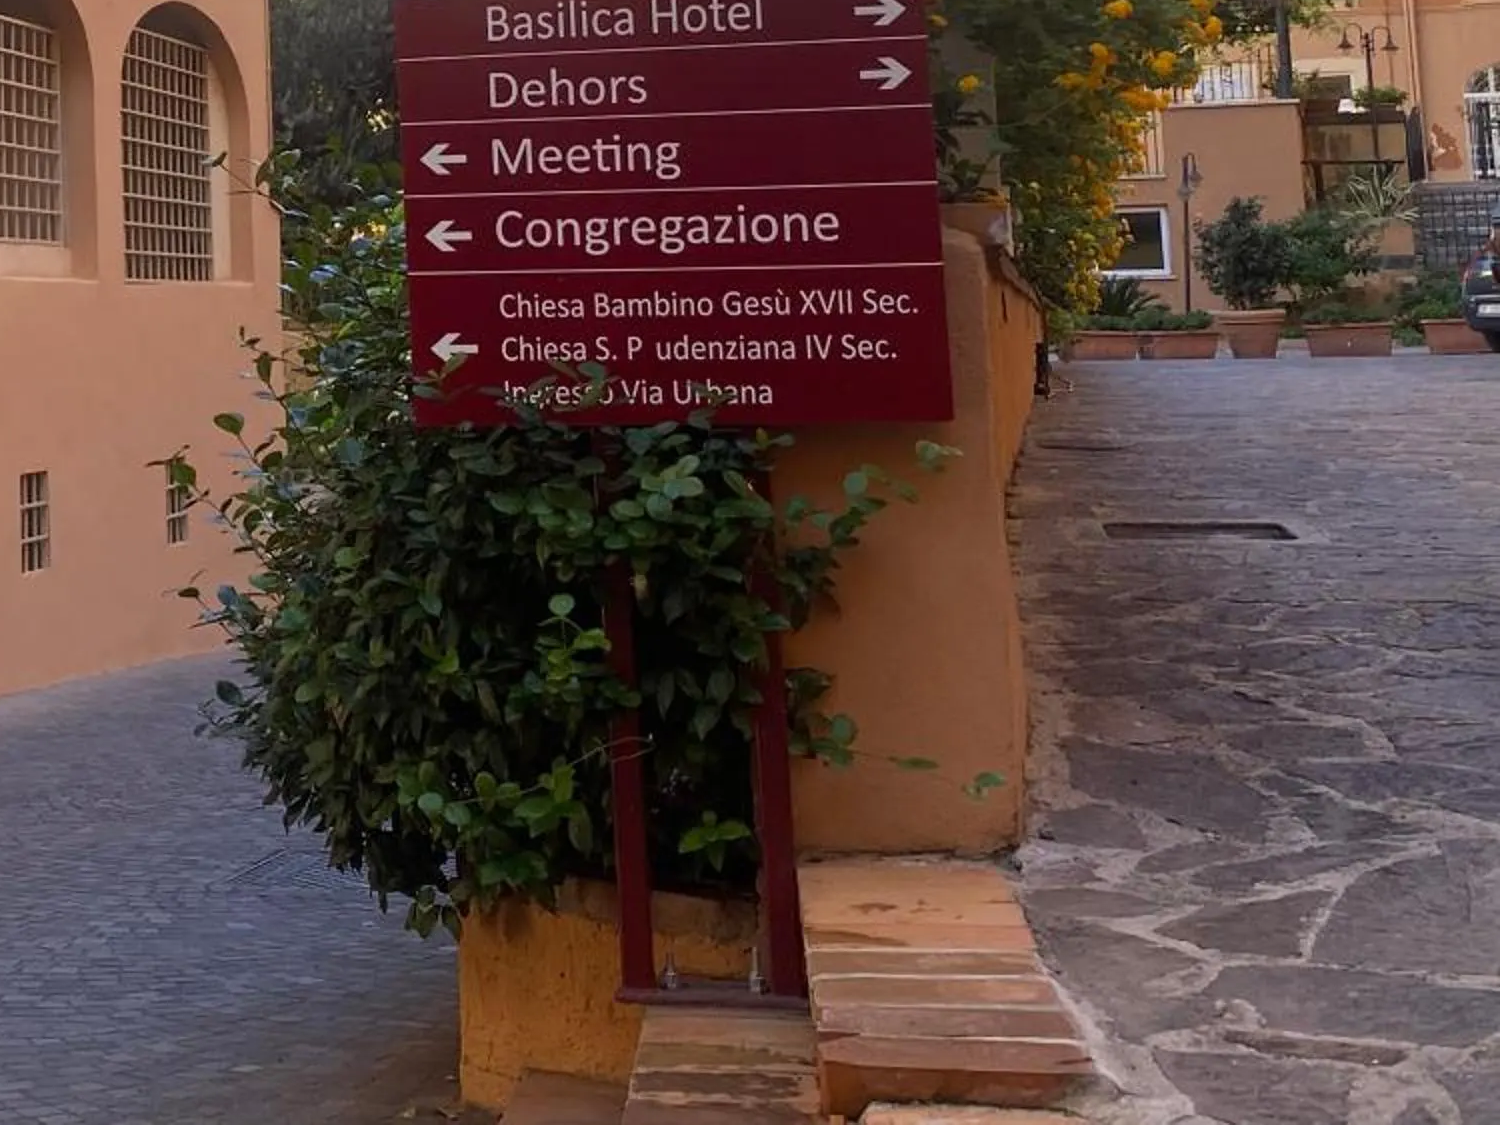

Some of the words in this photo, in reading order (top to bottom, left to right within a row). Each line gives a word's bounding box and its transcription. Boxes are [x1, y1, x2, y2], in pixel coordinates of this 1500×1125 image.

[488, 67, 648, 109] Dehors
[491, 133, 681, 180] Meeting
[495, 204, 840, 256] Congregazione
[499, 291, 585, 319] Chiesa
[594, 289, 714, 318] Bambino
[722, 287, 791, 317] Gesù
[799, 288, 853, 315] XVII
[862, 287, 919, 315] Sec.
[501, 335, 587, 362] Chiesa
[595, 336, 618, 361] S.
[805, 334, 833, 360] IV
[841, 333, 898, 360] Sec.
[621, 378, 664, 405] Via
